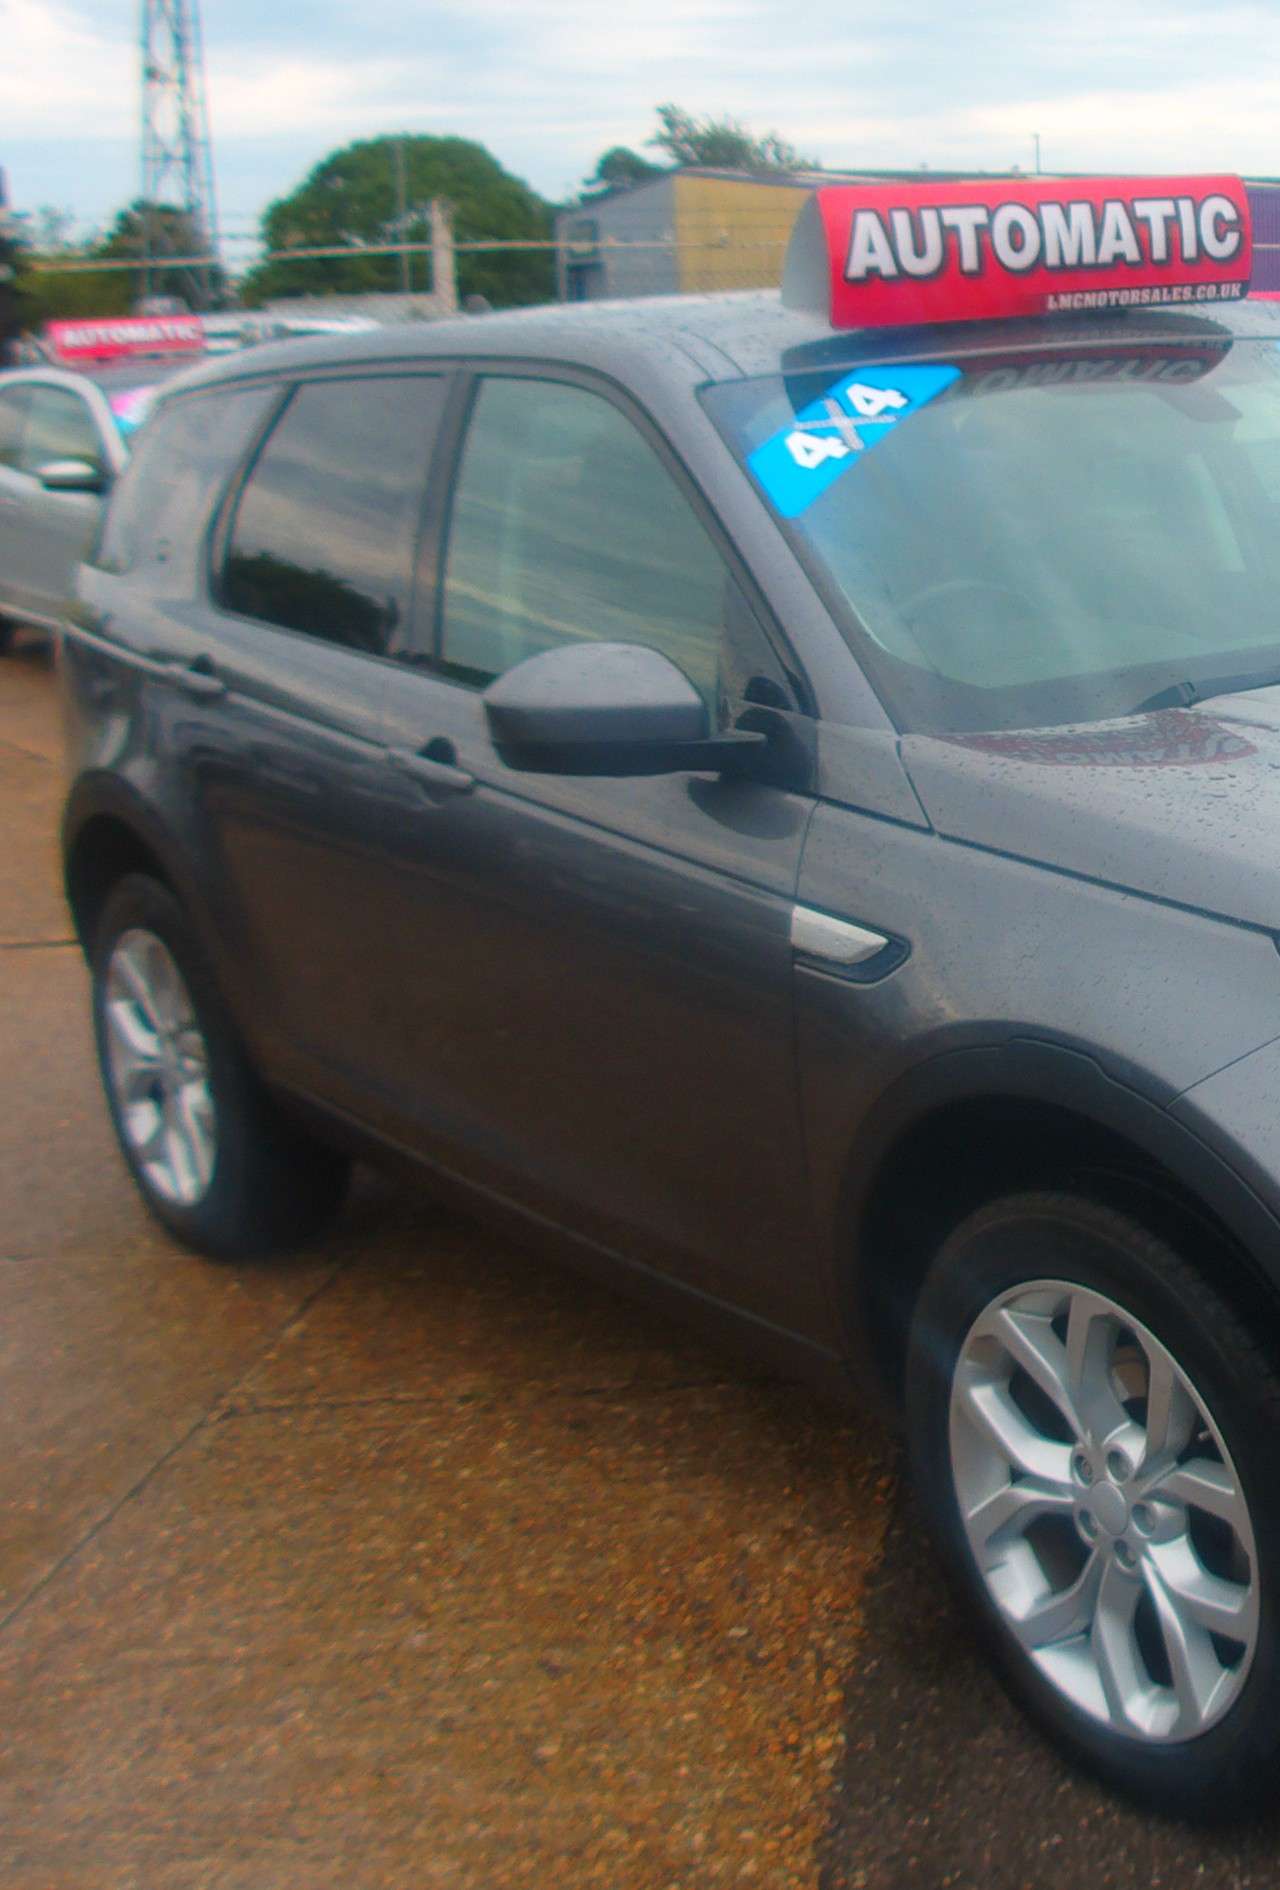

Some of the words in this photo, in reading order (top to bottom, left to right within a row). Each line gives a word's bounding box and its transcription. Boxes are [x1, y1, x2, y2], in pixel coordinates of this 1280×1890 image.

[845, 195, 1241, 281] AUTOMATIC
[1047, 283, 1242, 311] LMCMOTORSALES.CO.UK
[62, 324, 198, 347] AUTOMATIC
